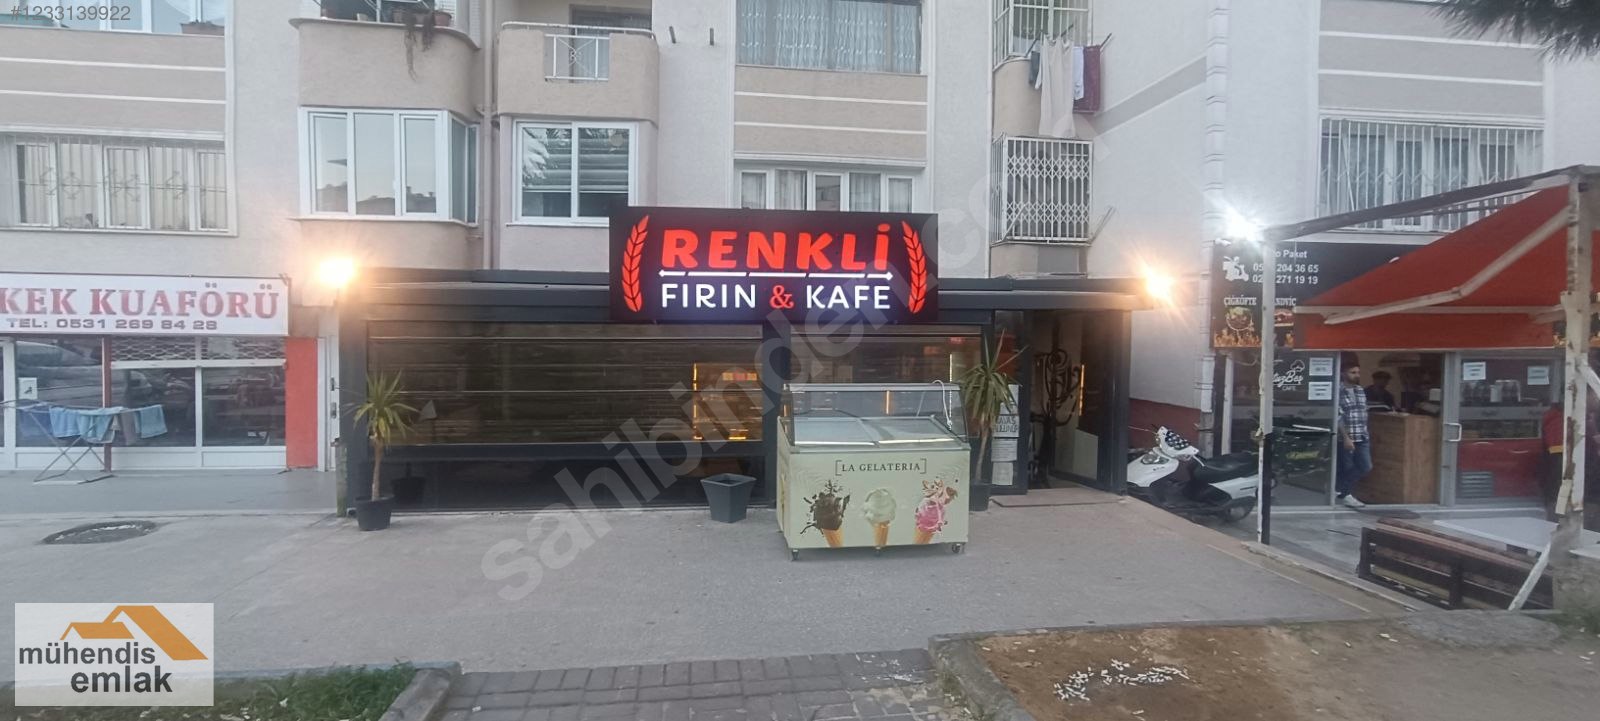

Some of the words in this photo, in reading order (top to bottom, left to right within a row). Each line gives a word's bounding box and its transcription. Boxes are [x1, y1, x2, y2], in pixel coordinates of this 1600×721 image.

[661, 223, 891, 271] RENKLİ
[1282, 249, 1308, 258] Paket
[1276, 263, 1293, 272] 204
[1294, 264, 1306, 273] 36
[1307, 264, 1319, 273] 65
[1276, 274, 1292, 283] 271
[1294, 275, 1306, 284] 19
[1307, 275, 1319, 285] 19
[0, 287, 77, 315] KEK
[89, 282, 279, 319] KUAFÖRÜ
[661, 283, 756, 309] FIRIN
[769, 285, 795, 309] &
[806, 285, 890, 310] KAFE
[6, 318, 48, 329] TEL:
[56, 318, 106, 329] 0531
[115, 319, 153, 330] 269
[161, 319, 186, 330] 84
[192, 320, 218, 331] 28
[841, 464, 855, 472] LA
[859, 462, 921, 472] GELATERIA
